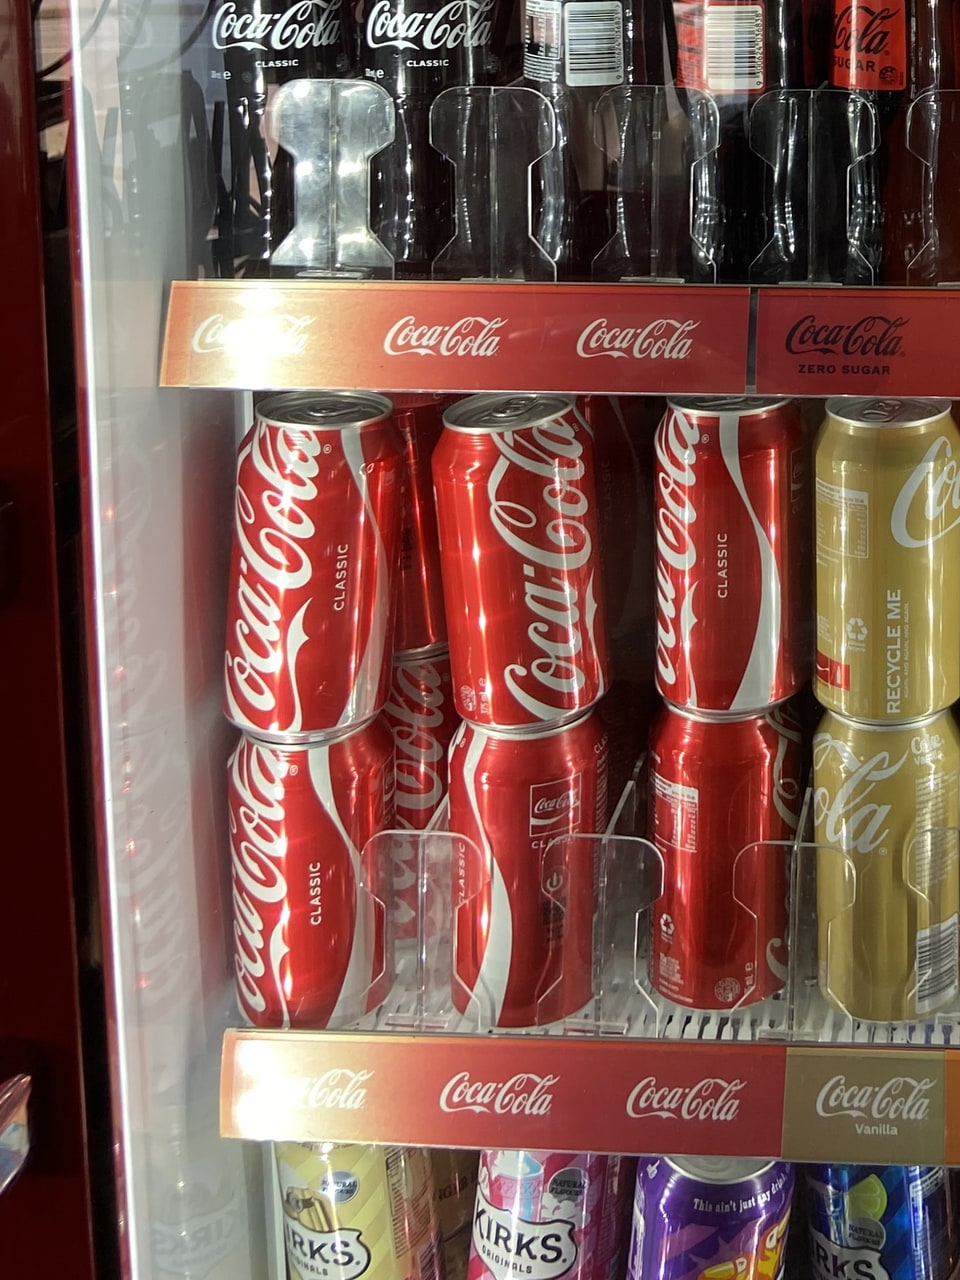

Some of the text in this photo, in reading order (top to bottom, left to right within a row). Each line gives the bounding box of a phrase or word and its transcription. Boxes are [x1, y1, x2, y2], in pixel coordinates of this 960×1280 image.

[255, 59, 299, 68] CLASSIC
[406, 59, 449, 68] CLASSIC
[383, 315, 508, 359] Coca-Cola
[576, 317, 701, 360] Coca-Cola
[785, 315, 911, 357] Coca-Cola
[798, 364, 890, 376] ZERO SUGAR
[333, 543, 349, 611] CLASSIC
[488, 408, 604, 722] Coca-Cola
[717, 533, 728, 599] CLASSIC
[887, 589, 901, 714] RECYCLE ME
[911, 734, 941, 755] Coke
[310, 861, 321, 925] CLASSIC
[300, 1068, 375, 1111] -Cola
[439, 1071, 560, 1117] Coca-Cola
[626, 1076, 748, 1122] Coca-Cola
[816, 1075, 937, 1121] Coca-Cola
[855, 1123, 899, 1137] Vanilla
[553, 1178, 585, 1189] NATURAL
[693, 1189, 771, 1214] This ain't just any
[849, 1224, 884, 1237] NATURAL
[482, 1248, 533, 1274] ORIGINALS
